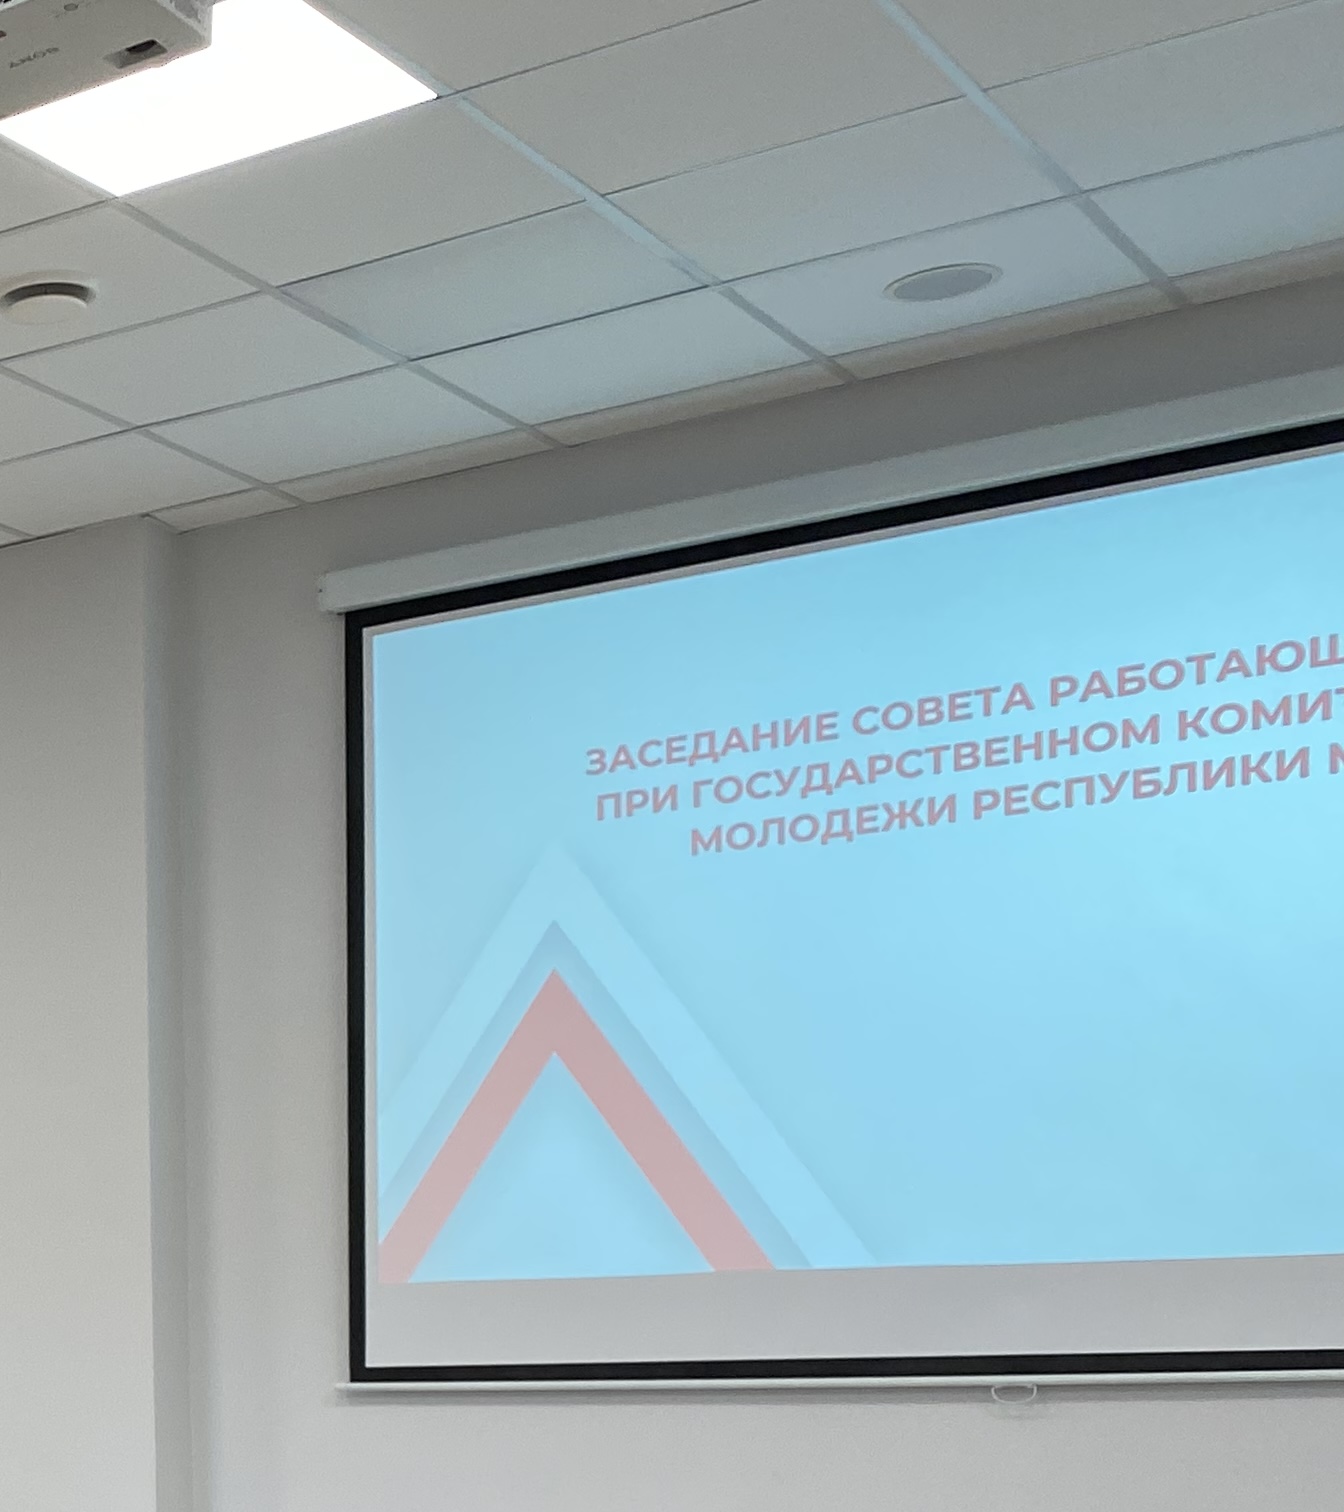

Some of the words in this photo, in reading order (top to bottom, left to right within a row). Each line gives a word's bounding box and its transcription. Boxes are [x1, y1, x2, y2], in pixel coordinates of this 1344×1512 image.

[585, 710, 840, 776] ЗАСЕДАНИЕ
[852, 681, 1036, 737] СОВЕТА
[595, 783, 679, 822] ПРИ
[692, 713, 1160, 810] ГОСУДАРСТВЕННОМ
[690, 794, 957, 857] МОЛОДЕЖИ
[972, 745, 1311, 820] РЕСПУБЛИКИ
